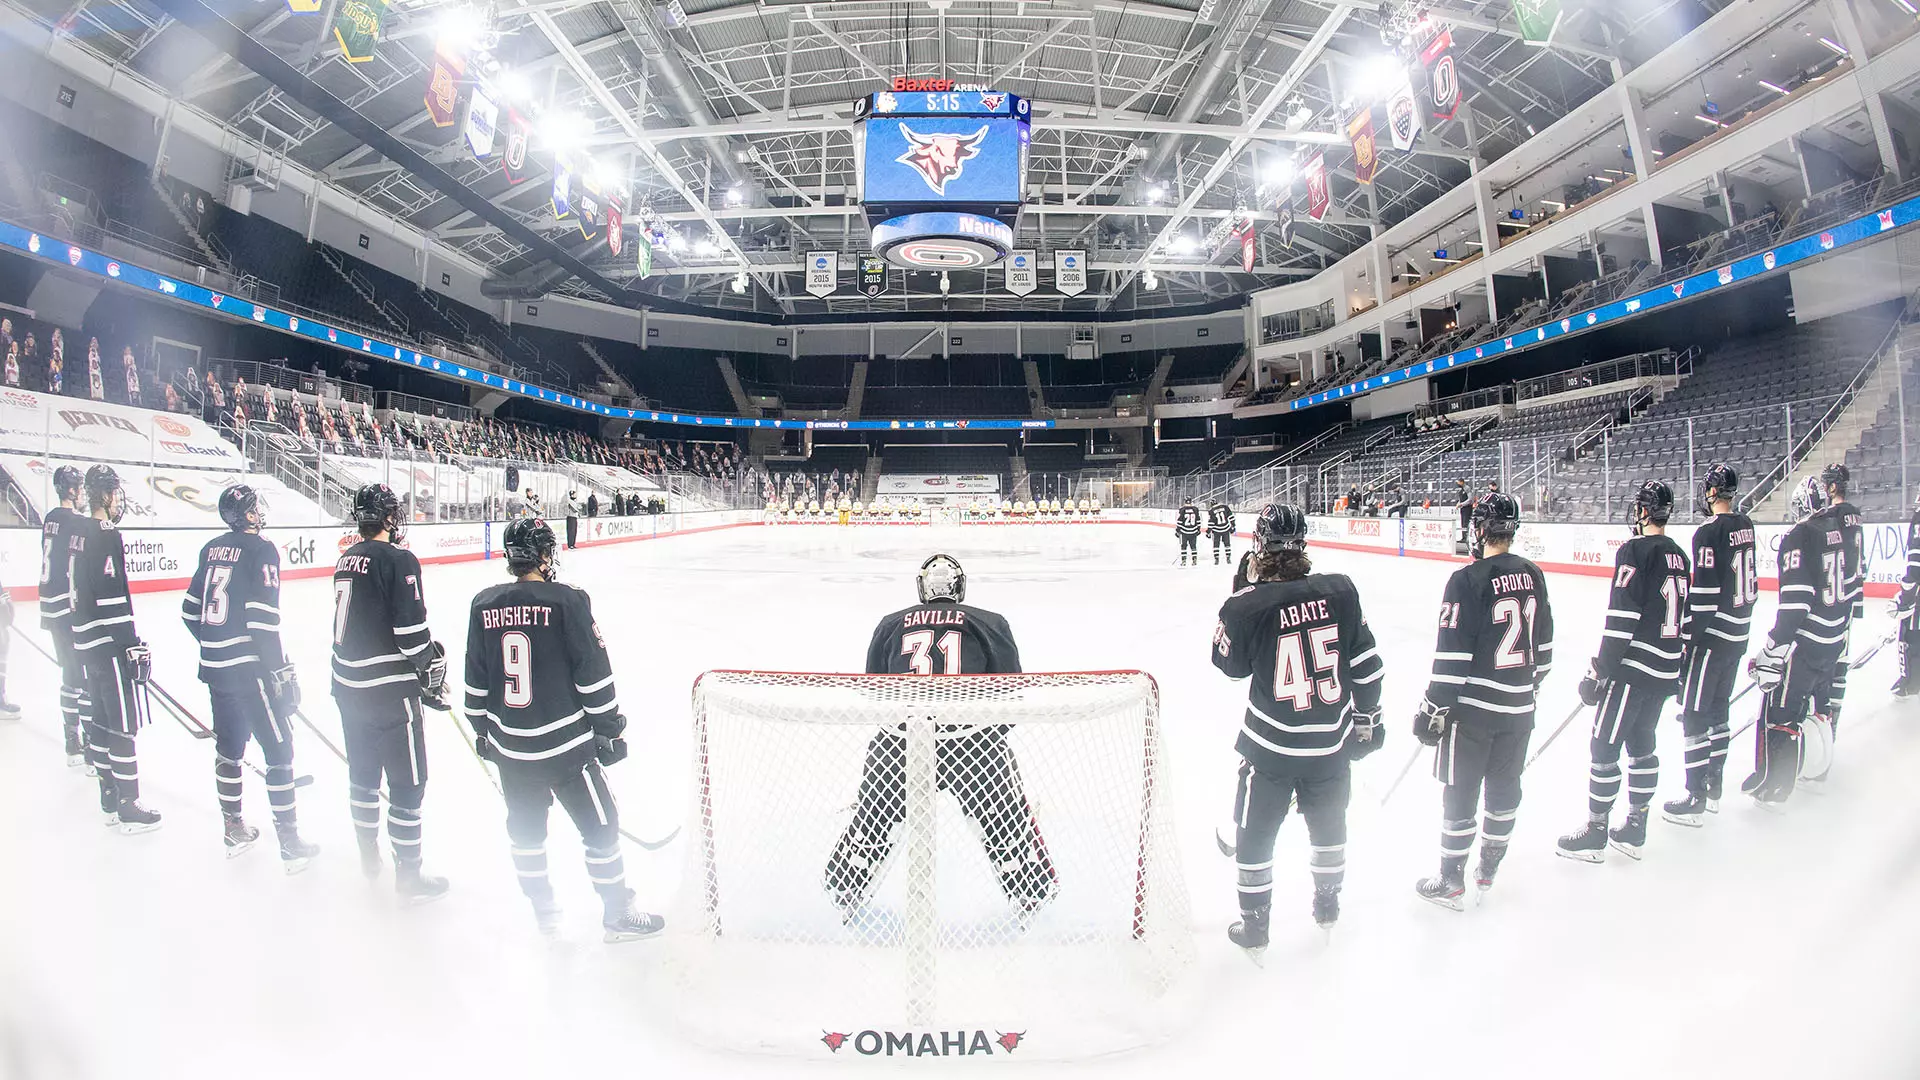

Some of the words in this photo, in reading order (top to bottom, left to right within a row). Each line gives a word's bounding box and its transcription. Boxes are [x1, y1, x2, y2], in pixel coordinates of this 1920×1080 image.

[893, 77, 955, 92] Baxter
[953, 83, 989, 92] ARENA
[926, 93, 960, 111] 5:15
[813, 275, 829, 283] 2015
[864, 274, 881, 283] 2015
[1013, 274, 1028, 282] 2011
[1062, 274, 1080, 282] 2006
[1567, 377, 1578, 387] 105
[57, 409, 149, 441] DENVER
[184, 440, 230, 458] bank
[608, 522, 634, 536] OMAHA
[1216, 511, 1225, 525] 11
[290, 537, 315, 564] ckf
[1573, 551, 1601, 563] MAVS
[1697, 546, 1714, 568] 16
[1783, 549, 1801, 572] 36
[104, 555, 116, 578] 4
[124, 557, 156, 573] atural
[159, 556, 178, 571] Gas
[262, 563, 280, 587] 13
[1615, 564, 1636, 588] 17
[405, 574, 421, 600] 7
[1730, 547, 1758, 608] 16
[1821, 549, 1846, 607] 36
[1871, 572, 1903, 583] SURG
[200, 565, 234, 626] 13
[1660, 575, 1688, 639] 17
[904, 609, 966, 628] SAVILLE
[1279, 599, 1331, 630] ABATE
[1439, 602, 1460, 629] 21
[1491, 594, 1537, 671] 21
[901, 629, 963, 675] 31
[501, 629, 533, 708] 9
[1273, 623, 1342, 712] 45
[854, 1029, 994, 1058] OMAHA
